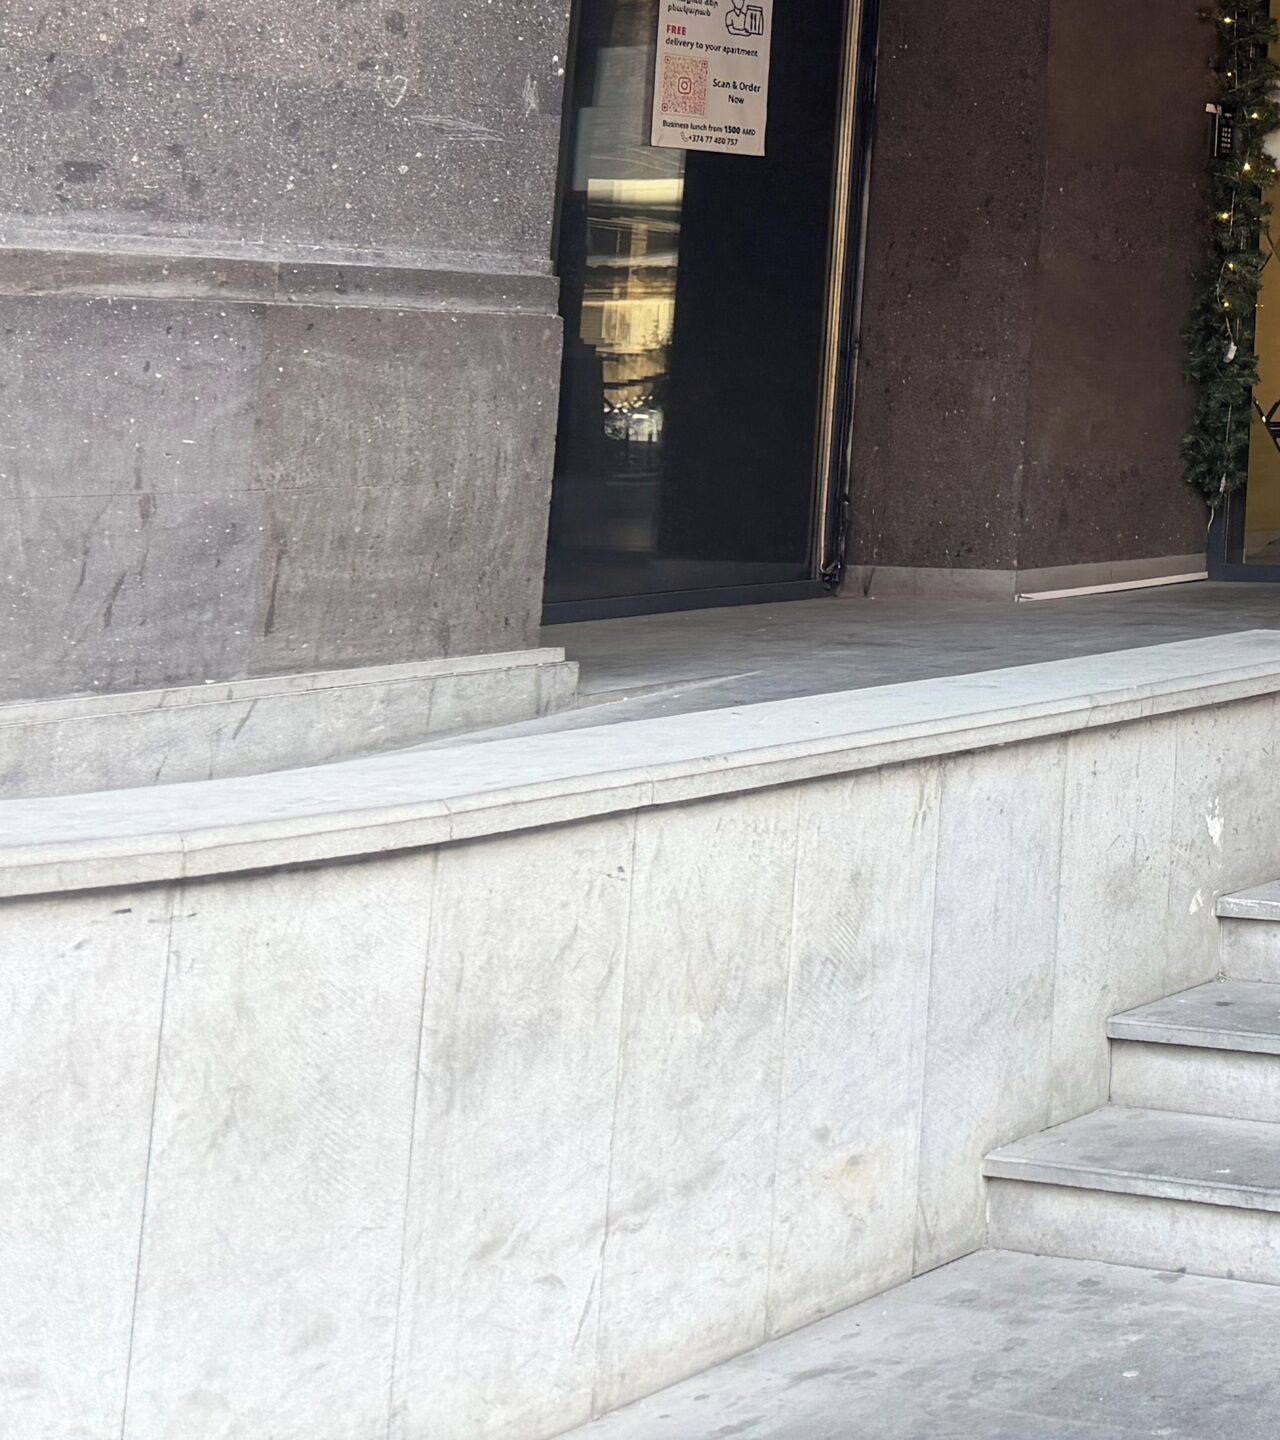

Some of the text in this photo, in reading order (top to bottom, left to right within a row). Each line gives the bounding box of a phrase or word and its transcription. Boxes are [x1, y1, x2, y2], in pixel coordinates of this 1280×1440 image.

[666, 24, 687, 36] FREE
[665, 37, 758, 58] delivery to your apartment
[712, 78, 761, 93] Scan & Order
[728, 94, 745, 105] Now
[662, 120, 756, 136] Business lunch from 1500 AMD
[705, 135, 713, 144] 77
